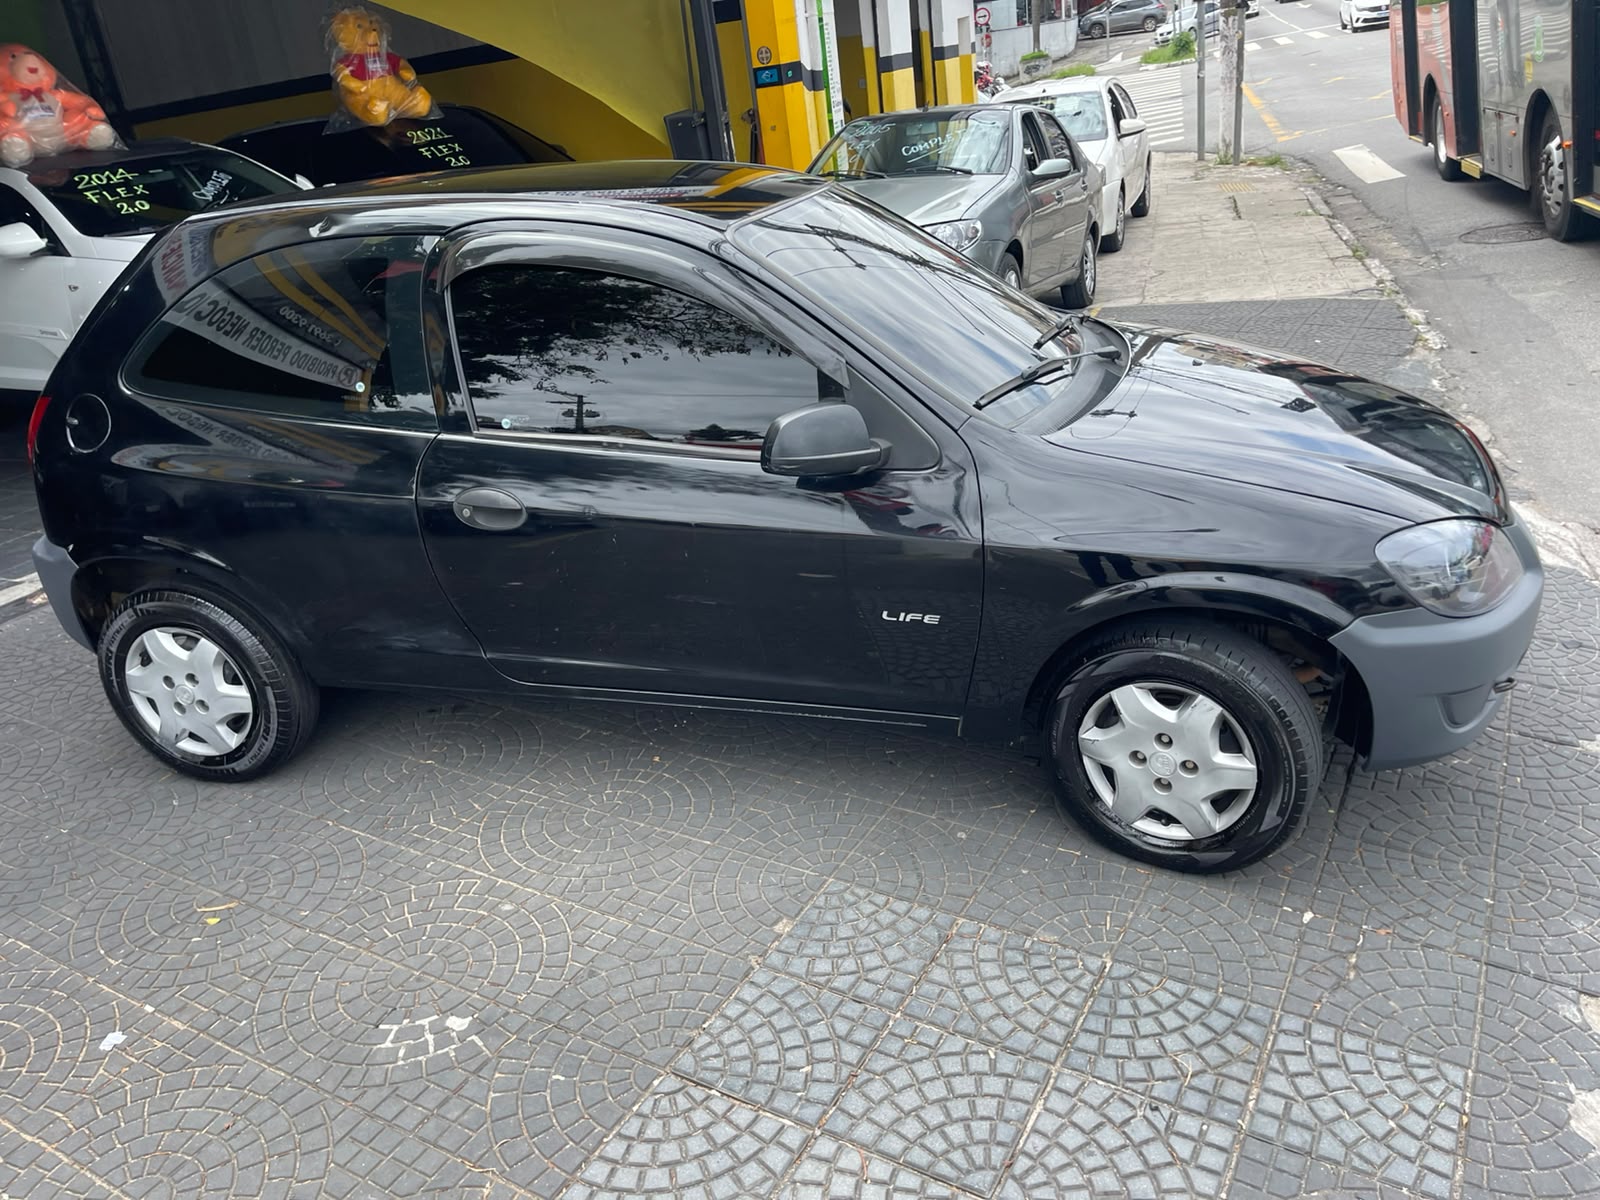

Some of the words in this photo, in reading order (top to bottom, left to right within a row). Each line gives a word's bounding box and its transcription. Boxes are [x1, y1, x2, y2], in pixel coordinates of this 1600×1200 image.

[406, 127, 454, 144] 2021
[418, 143, 463, 158] FLEX
[83, 184, 150, 203] FLEX
[116, 200, 150, 214] 2.0
[882, 610, 941, 625] LIFE
